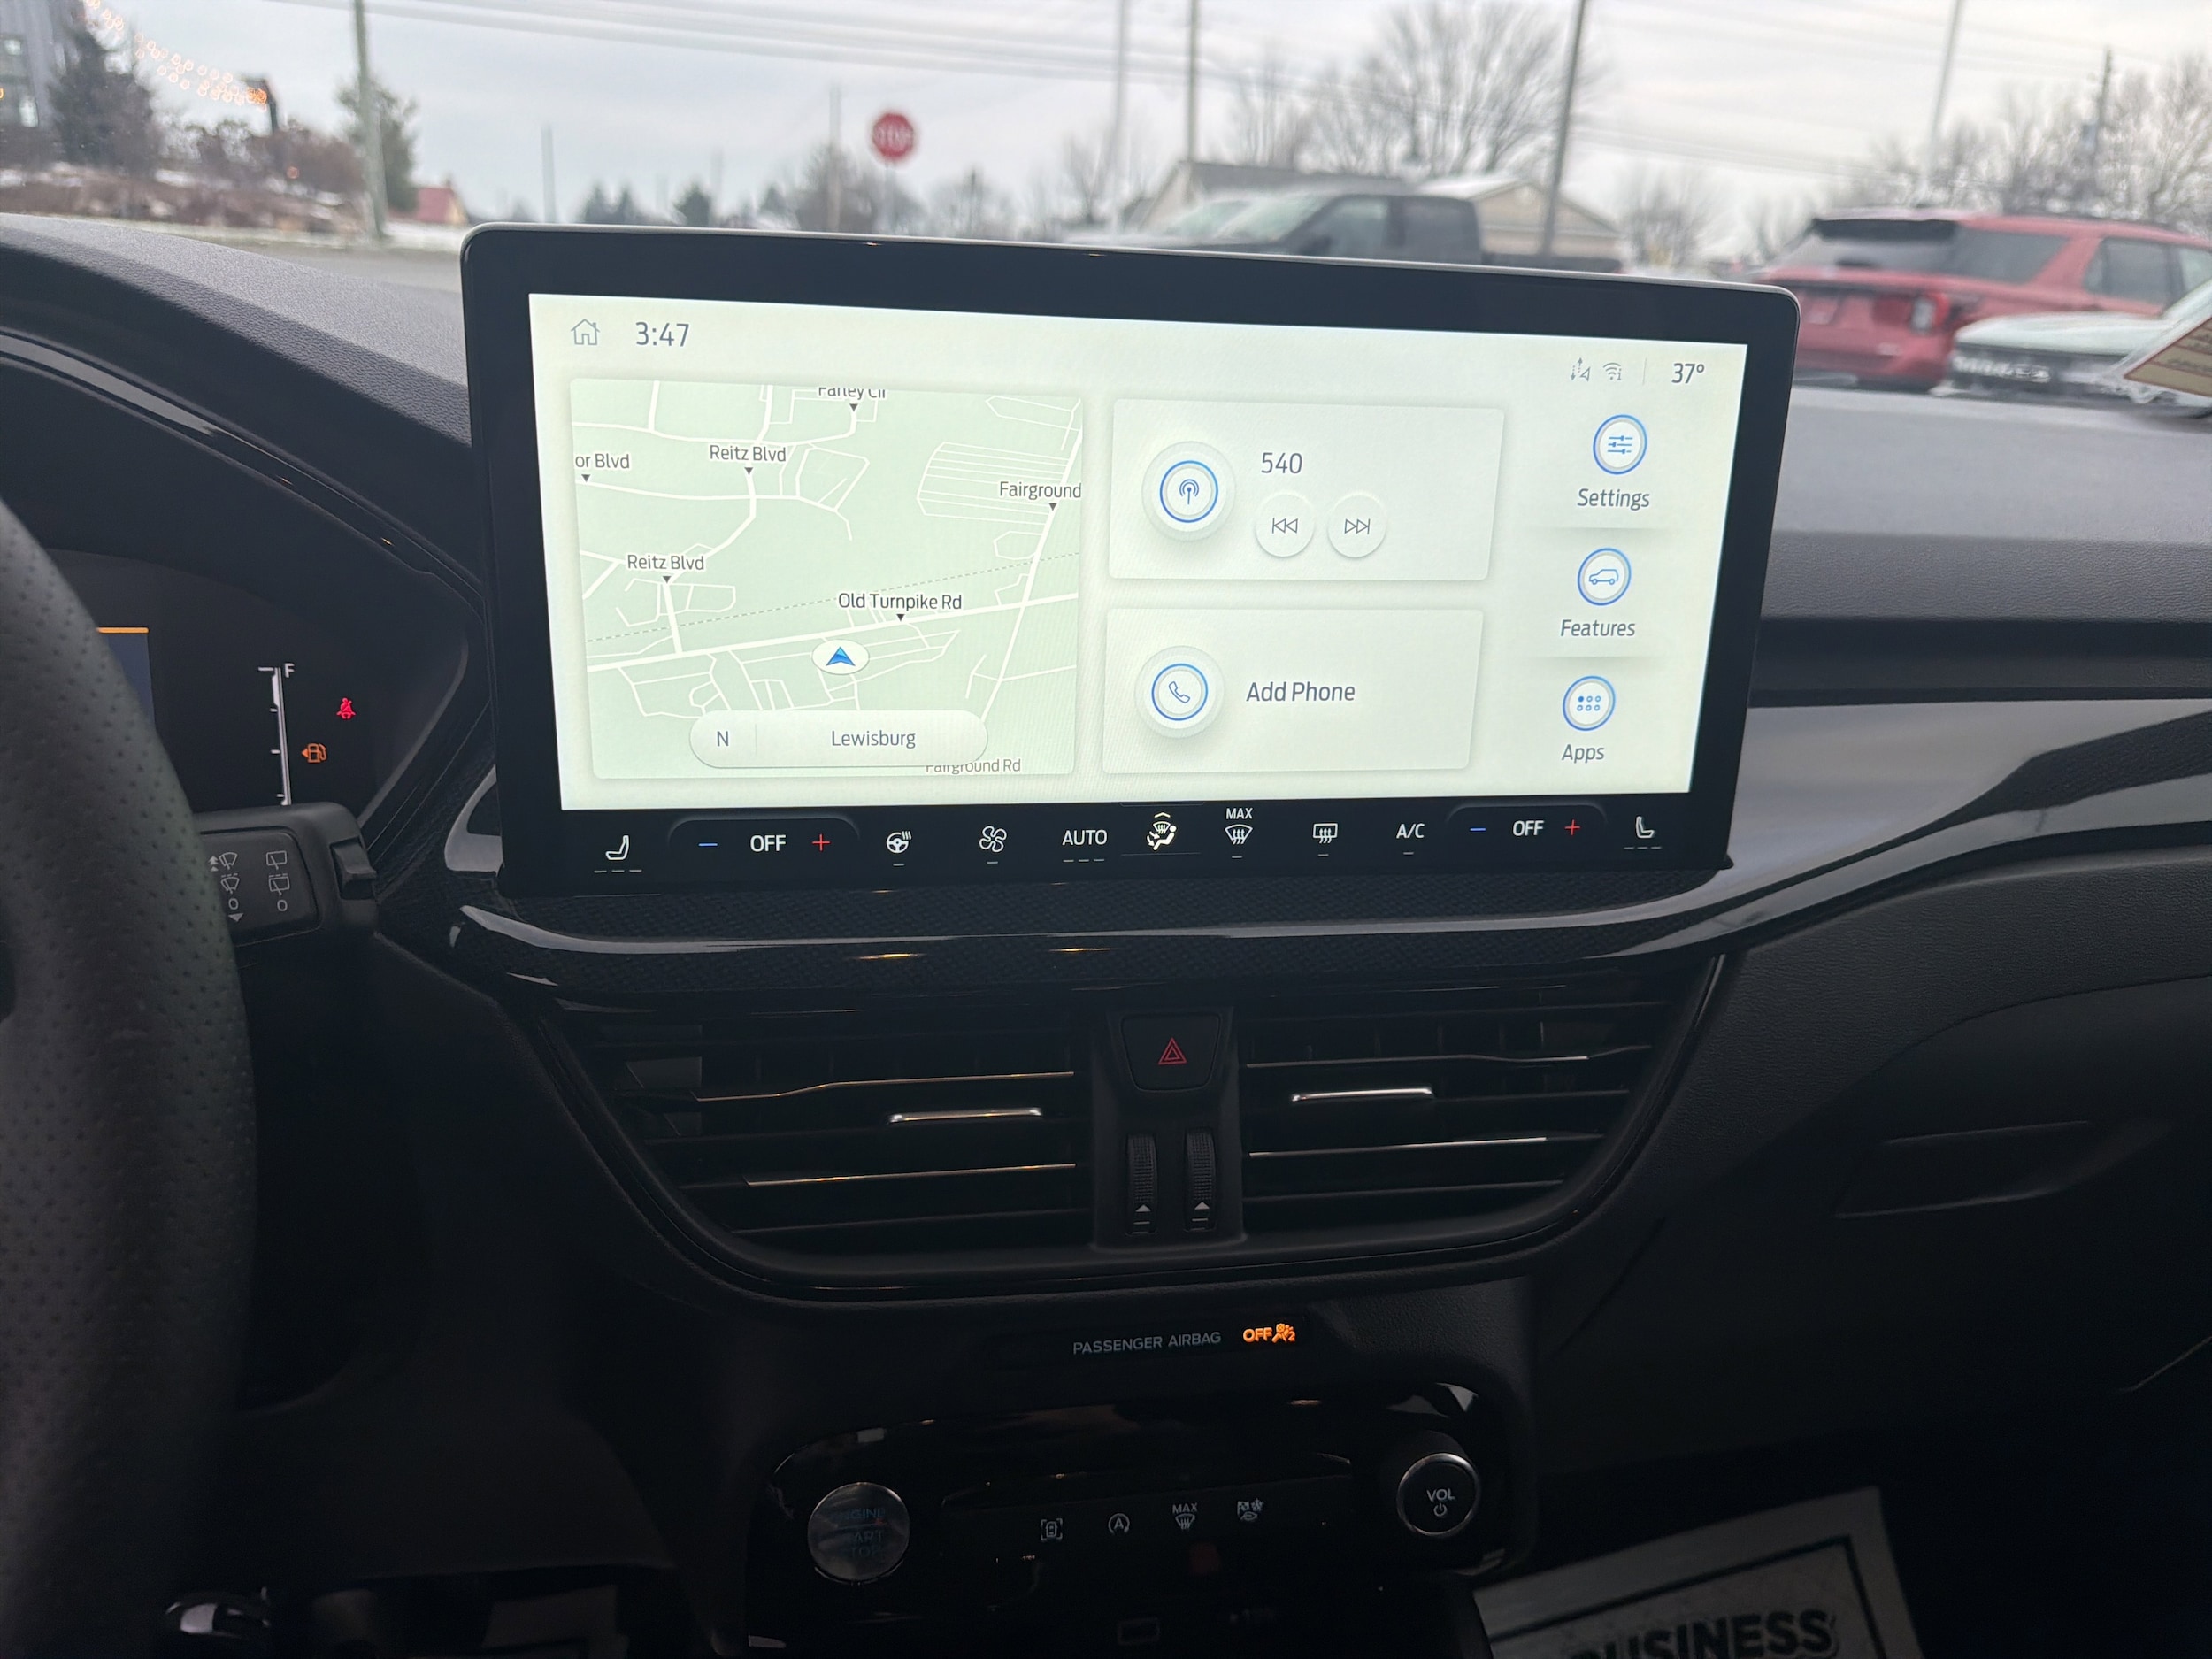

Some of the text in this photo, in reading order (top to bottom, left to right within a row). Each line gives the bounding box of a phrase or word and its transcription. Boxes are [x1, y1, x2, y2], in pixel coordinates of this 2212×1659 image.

[635, 321, 690, 347] 3:47
[574, 452, 630, 469] or Blvd
[710, 444, 787, 462] Reitz Blvd
[1261, 451, 1302, 474] 540
[1000, 480, 1081, 501] Fairground
[1577, 488, 1650, 511] Settings
[627, 554, 704, 571] Reitz Blvd
[838, 592, 962, 611] Old Turnpike Rd
[1560, 618, 1636, 637] Features
[284, 663, 295, 678] F
[1245, 680, 1356, 702] Add Phone
[717, 730, 729, 747] N
[832, 729, 916, 750] Lewisburg
[1561, 743, 1605, 764] Apps
[1002, 758, 1021, 772] Rd
[1225, 807, 1253, 820] MAX
[1395, 822, 1425, 839] A/C
[1512, 819, 1545, 837] OFF
[750, 834, 787, 853] OFF
[1062, 829, 1108, 846] AUTO
[1072, 1331, 1222, 1355] PASSENGER AIRBAG
[1242, 1326, 1272, 1342] OFF
[1426, 1488, 1455, 1502] VOL
[1171, 1502, 1198, 1516] MAX
[1571, 1610, 1834, 1659] SINESS
